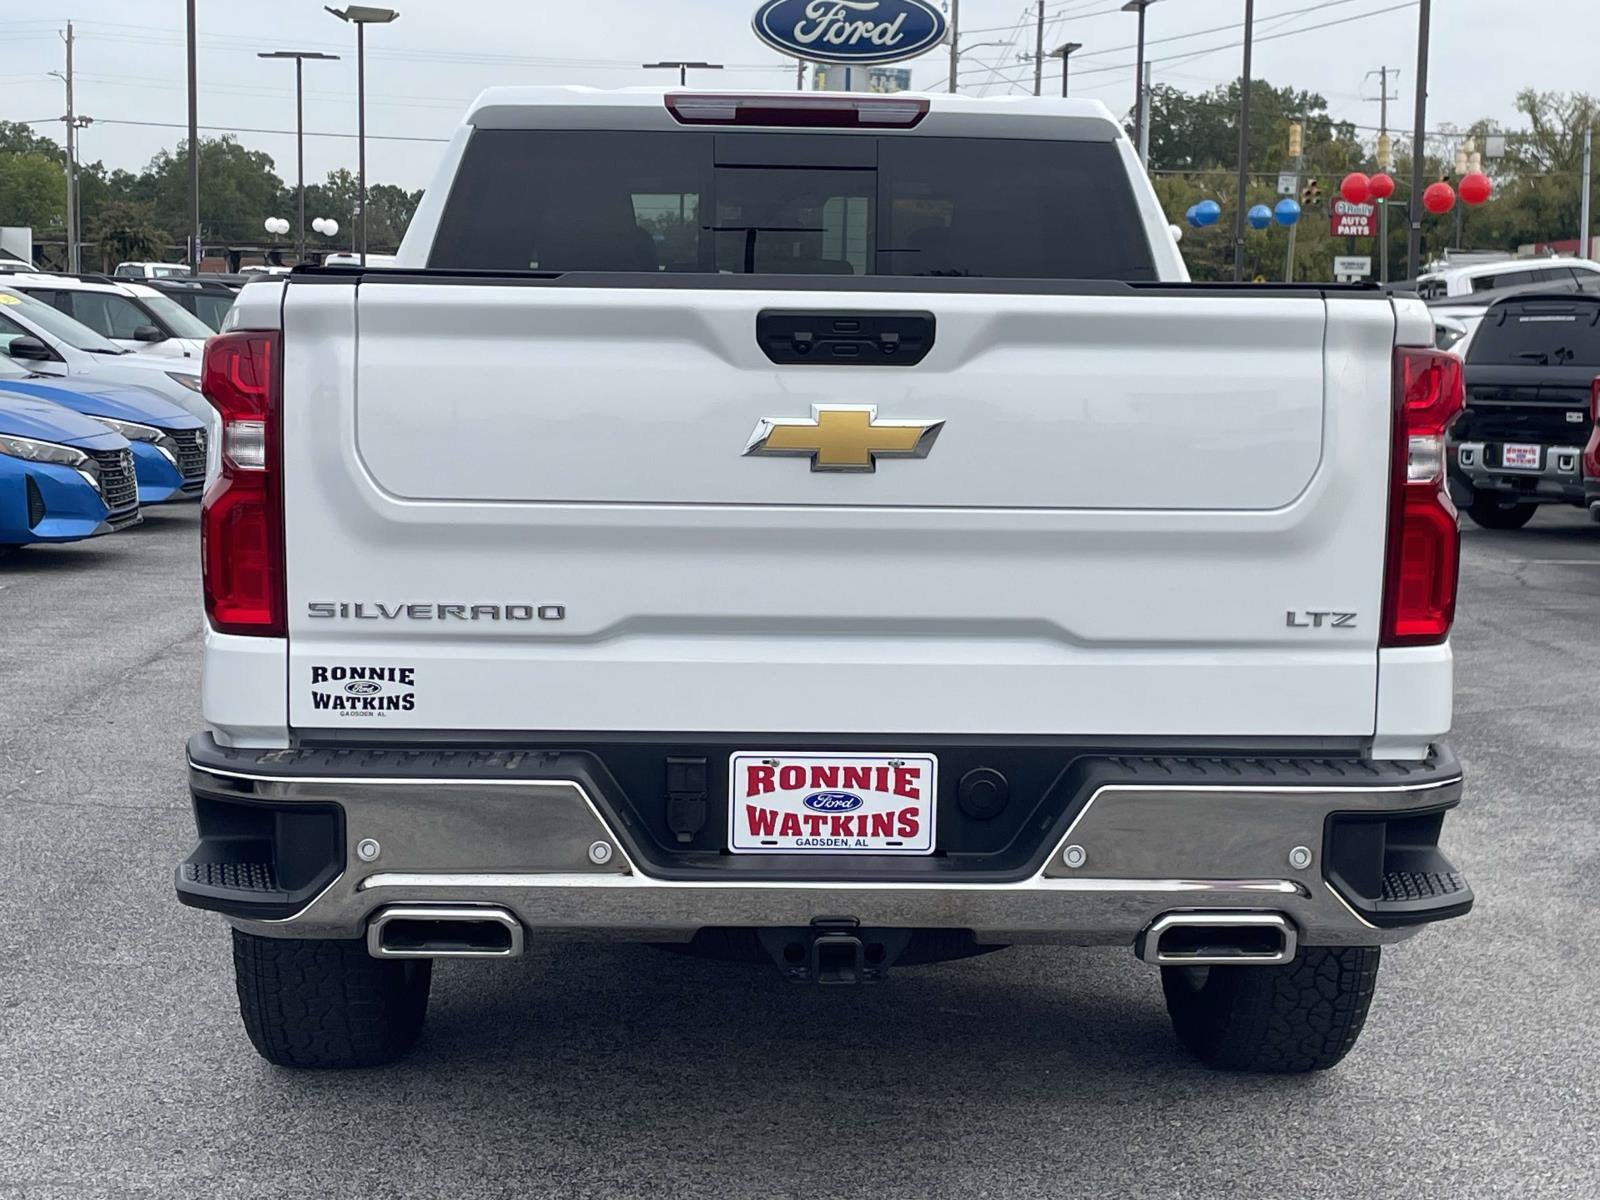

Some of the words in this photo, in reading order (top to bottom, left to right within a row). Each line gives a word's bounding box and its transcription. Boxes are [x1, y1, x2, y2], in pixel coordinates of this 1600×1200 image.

[793, 0, 907, 46] Ford
[1341, 216, 1368, 225] AUTO
[1337, 225, 1370, 235] PARTS
[308, 602, 566, 620] SILVERADO
[1286, 611, 1357, 628] LTZ
[312, 666, 415, 686] RONNIE
[312, 691, 415, 711] WATKINS
[746, 765, 920, 800] RONNIE
[811, 793, 855, 810] Ford
[746, 804, 920, 838] WATKINS
[795, 838, 851, 848] GADSDEN,
[855, 838, 869, 847] AL
